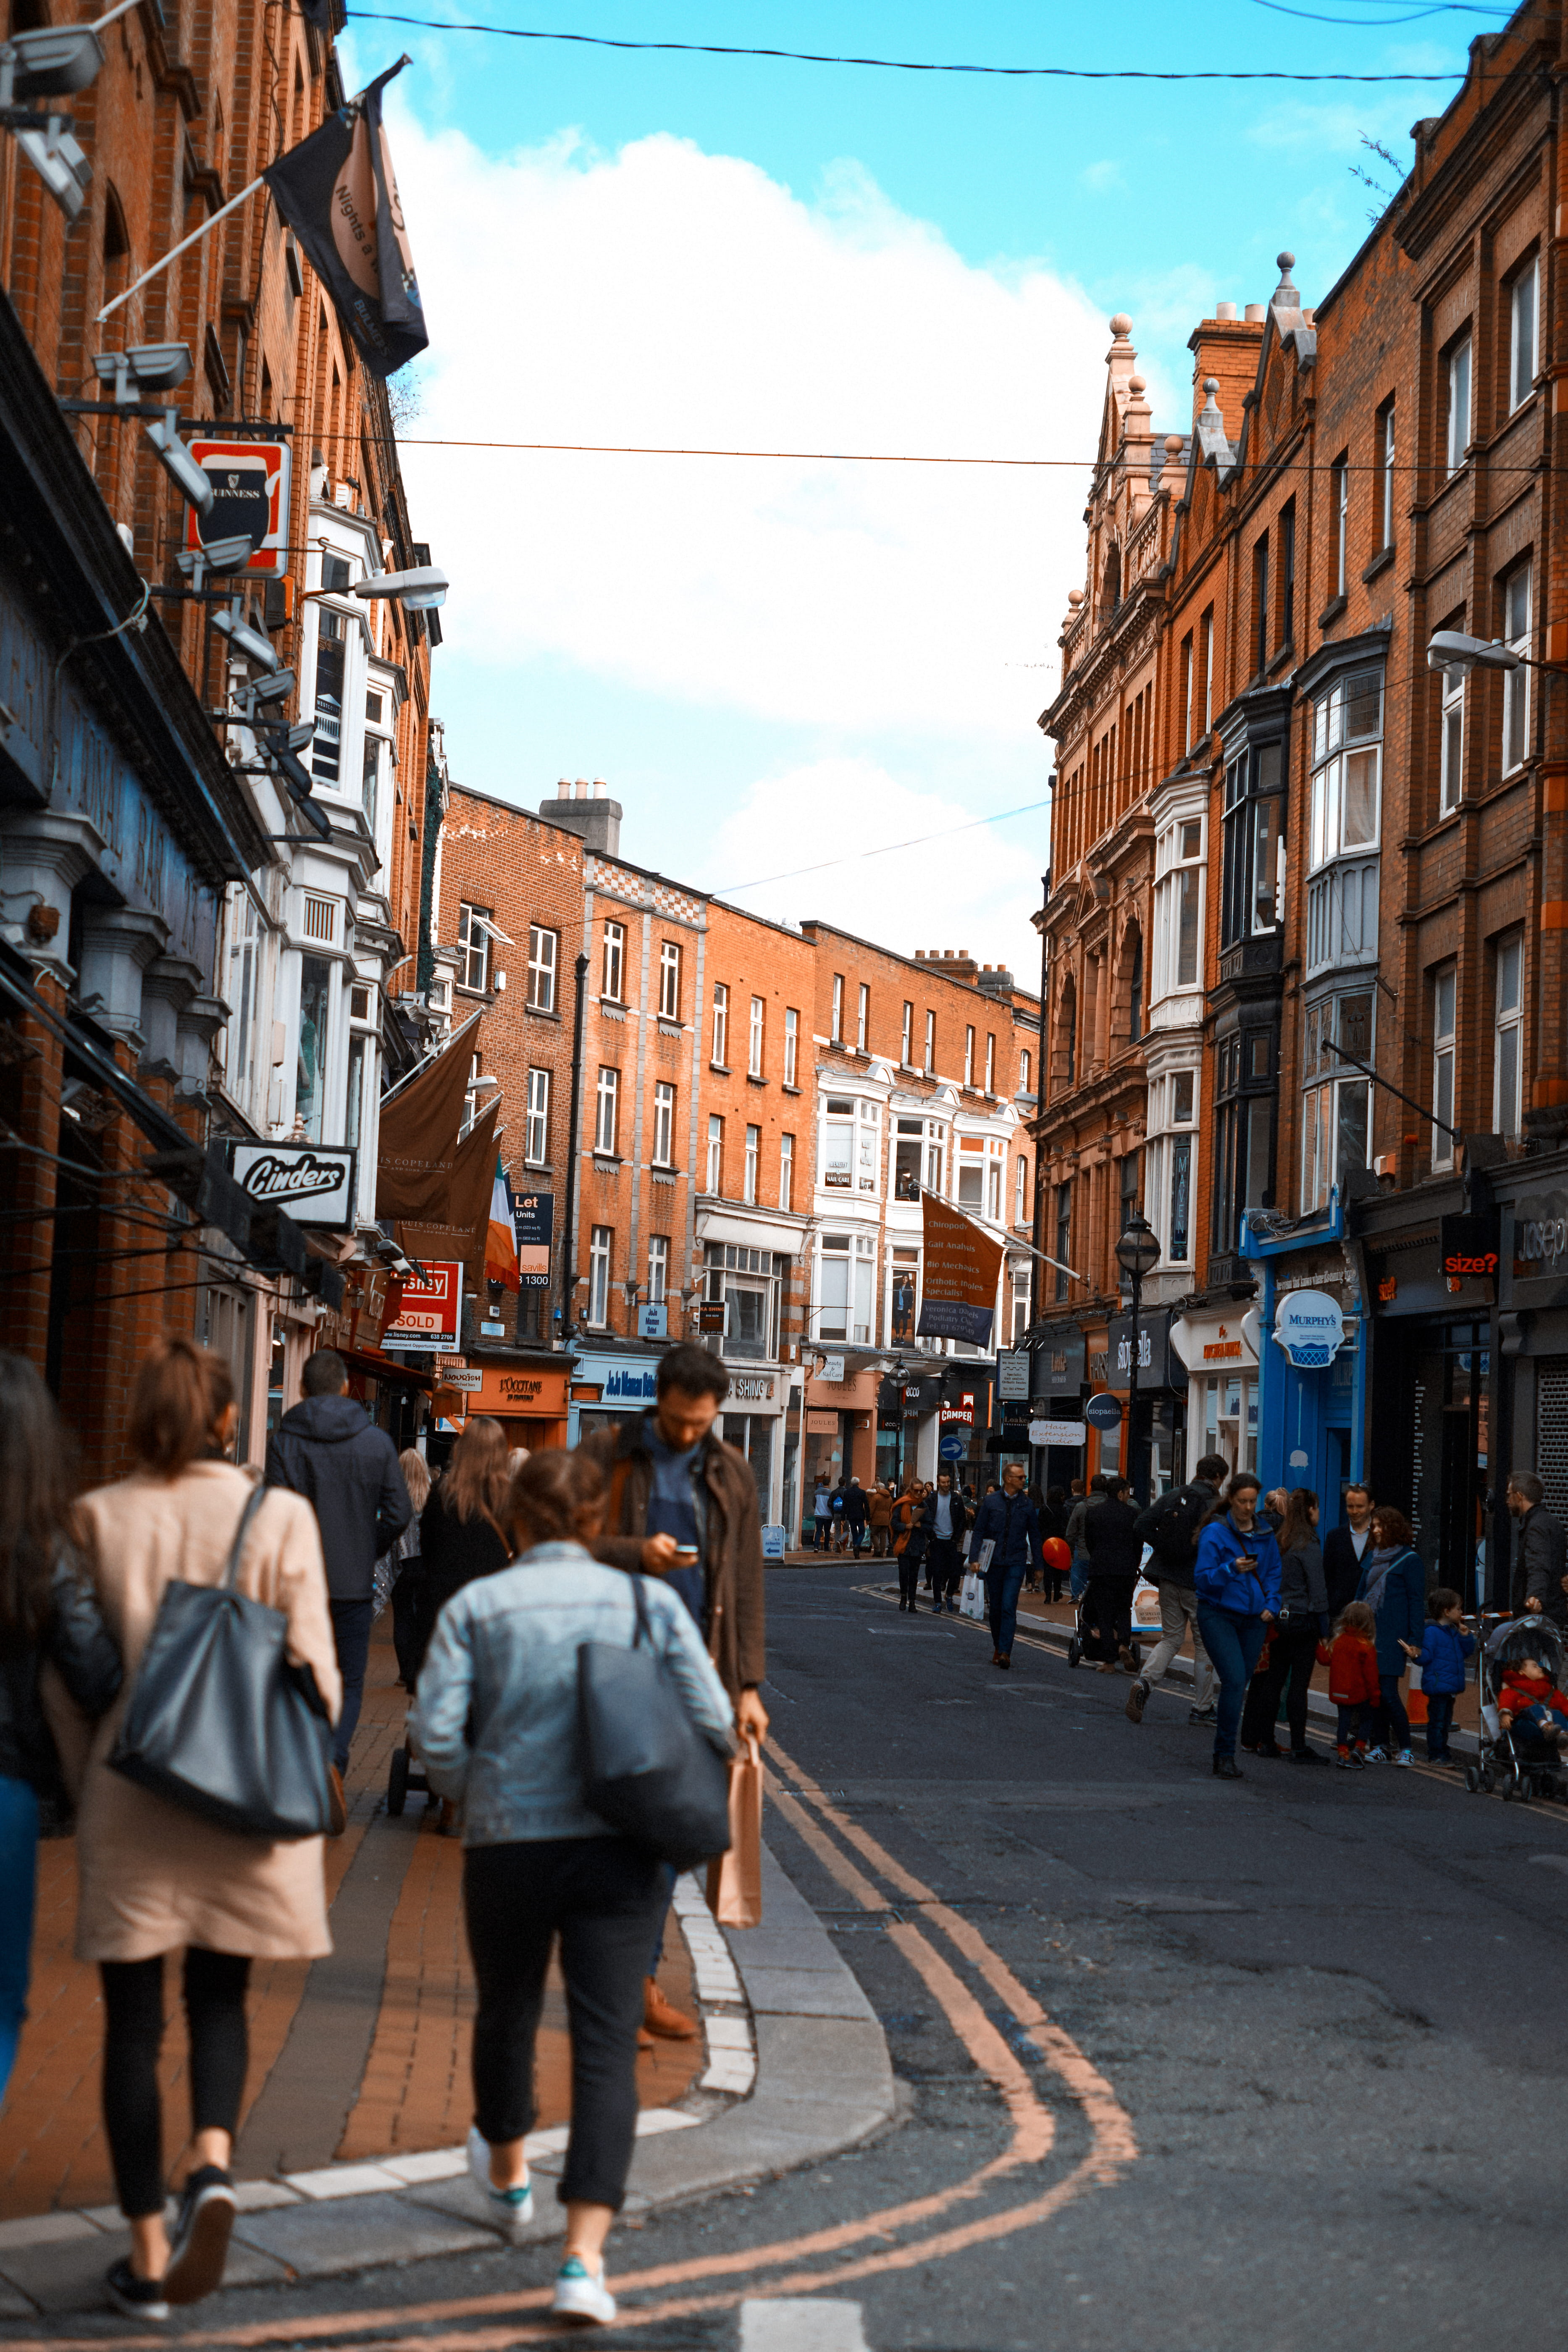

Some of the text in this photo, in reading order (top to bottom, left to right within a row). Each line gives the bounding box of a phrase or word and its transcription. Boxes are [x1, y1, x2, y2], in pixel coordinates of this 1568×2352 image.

[336, 184, 366, 242] Nights
[395, 1158, 453, 1169] COPELAND
[247, 1160, 340, 1200] Cinders
[515, 1195, 538, 1208] Let
[1178, 1156, 1187, 1234] MAVEN
[928, 1221, 968, 1230] Chiropody
[522, 1263, 547, 1272] savills
[1445, 1253, 1498, 1273] size?
[394, 1273, 444, 1294] isney
[525, 1276, 548, 1285] 1300
[926, 1278, 983, 1291] Orthotic Inoles
[926, 1288, 963, 1297] Specialist
[925, 1305, 956, 1314] Veronica
[397, 1315, 434, 1328] SOLD
[1289, 1314, 1336, 1326] MURPHY'S
[738, 1378, 764, 1396] SHING
[906, 1386, 920, 1397] ecco
[942, 1410, 972, 1423] CAMPER
